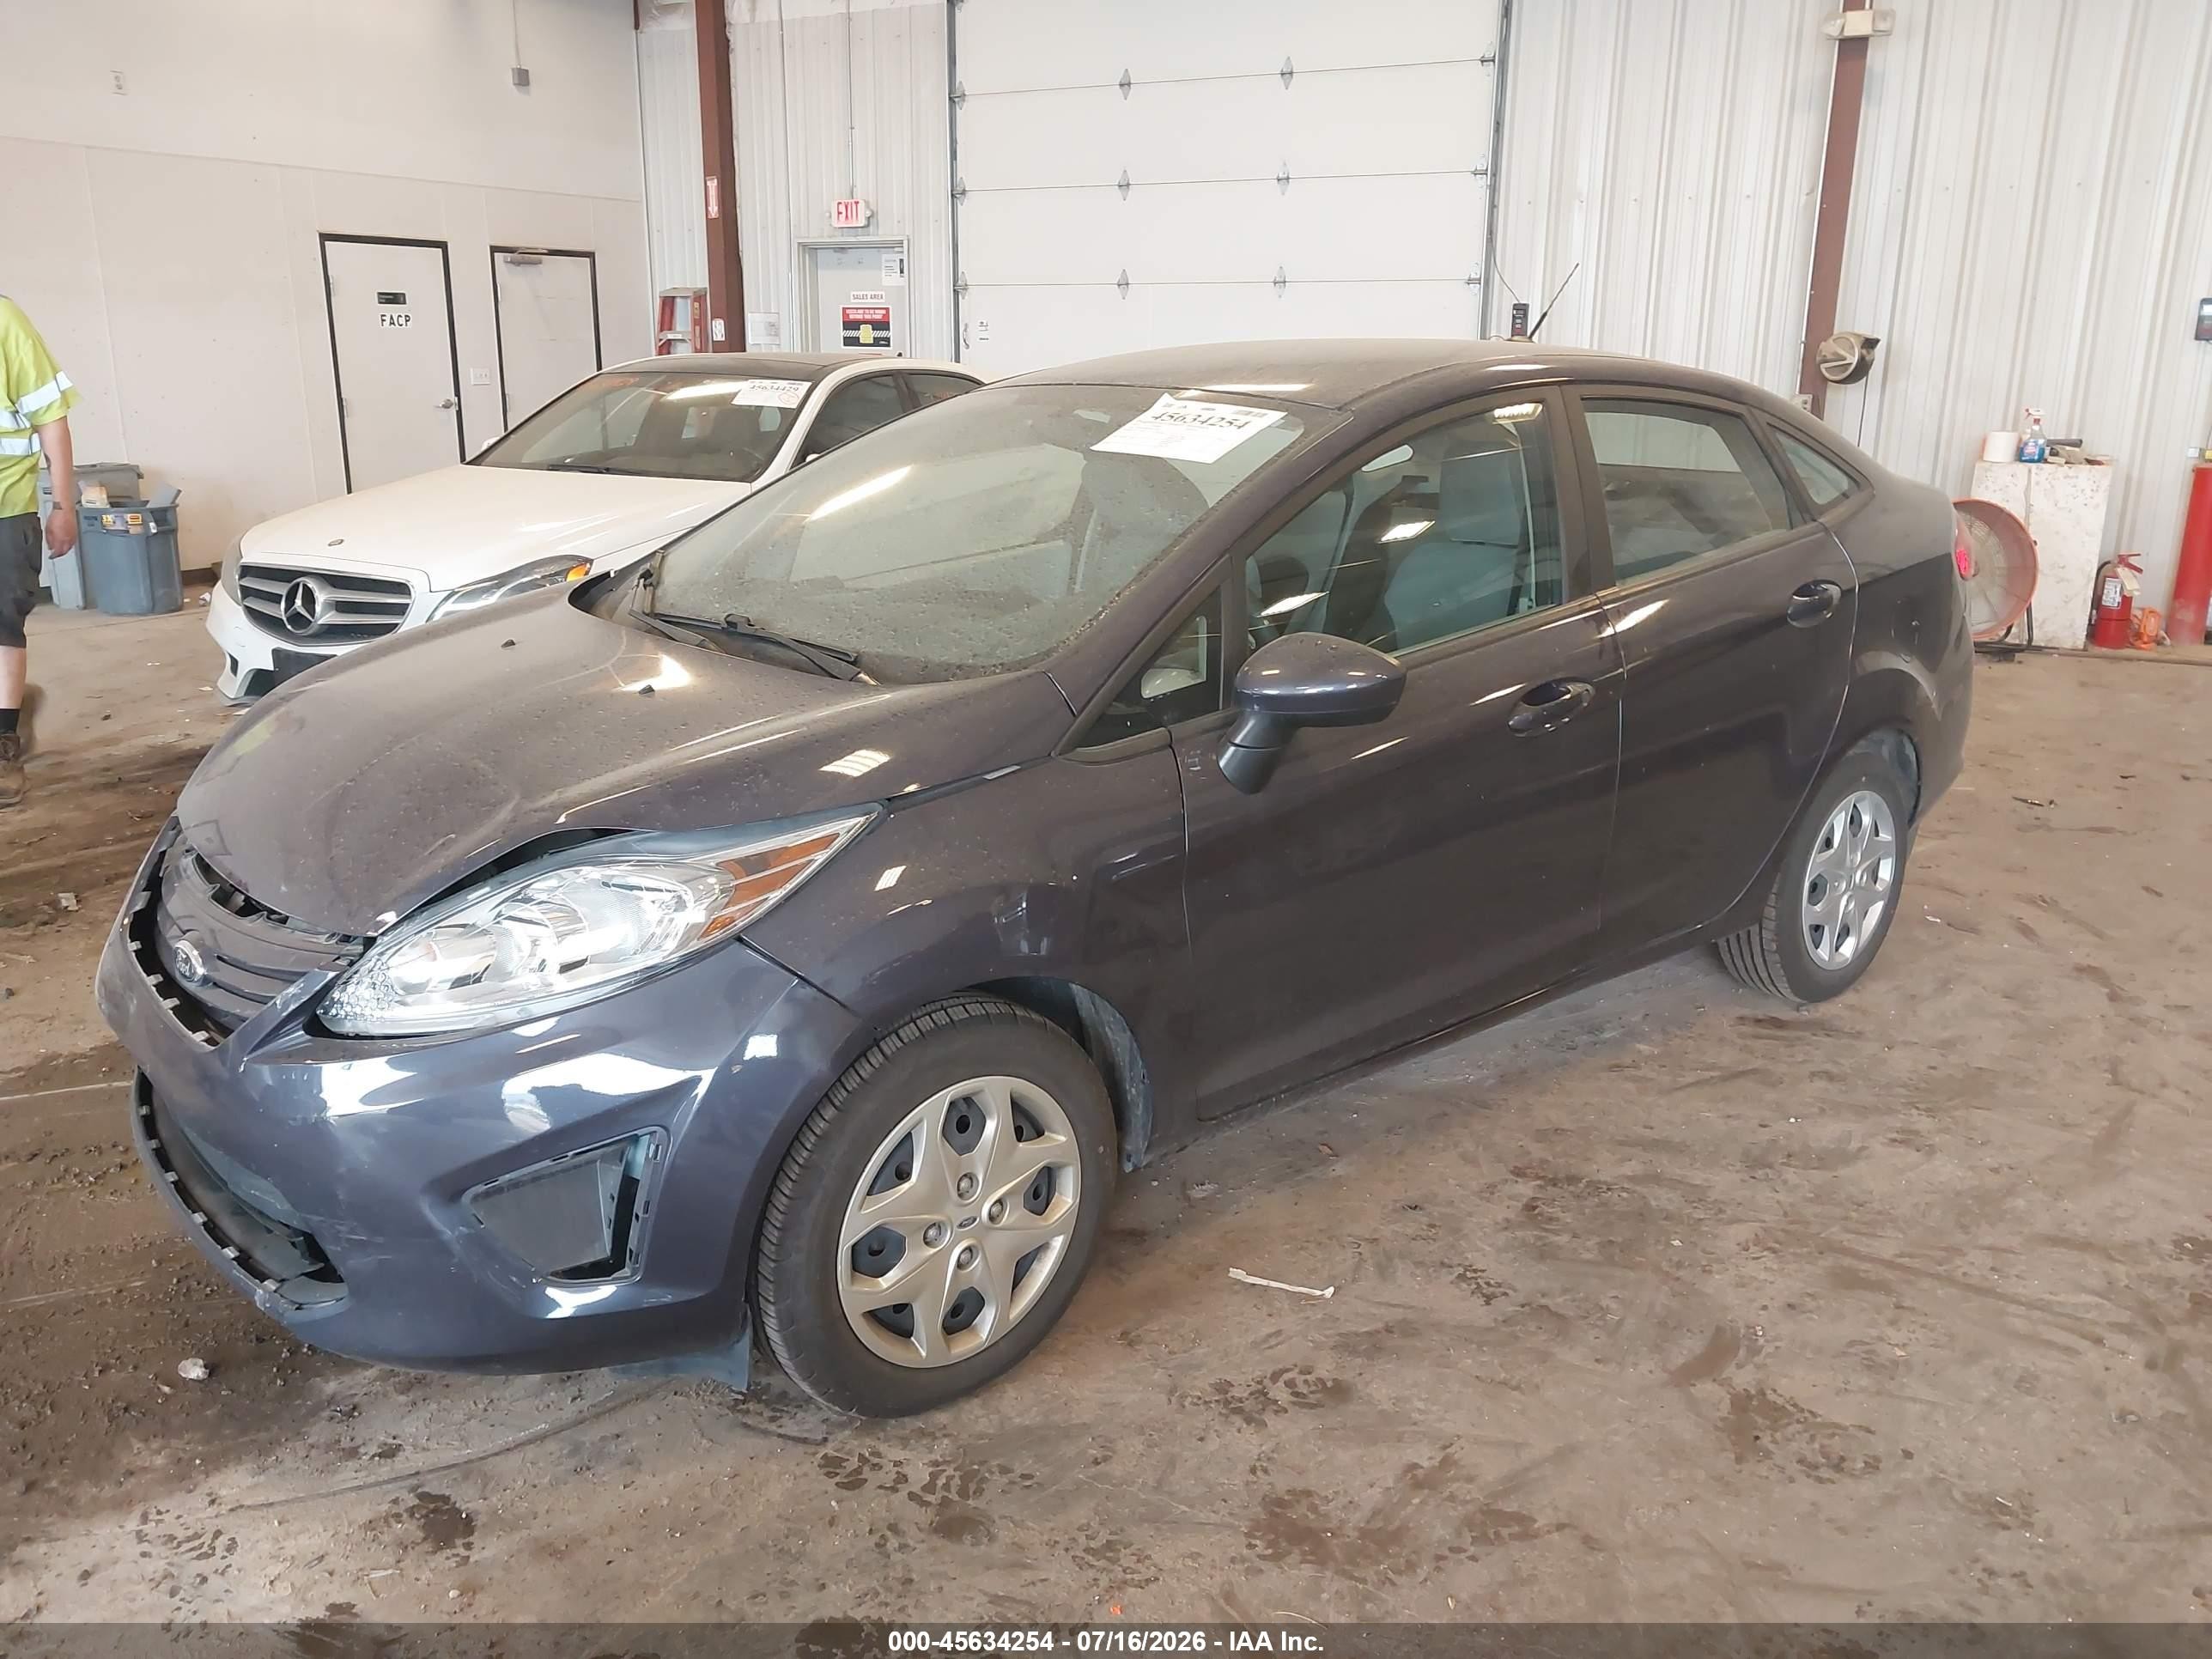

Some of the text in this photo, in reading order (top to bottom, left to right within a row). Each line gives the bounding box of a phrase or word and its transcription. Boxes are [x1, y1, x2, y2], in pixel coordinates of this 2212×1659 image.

[836, 201, 860, 221] EXIT
[380, 314, 410, 326] FACP
[1152, 411, 1251, 429] 45634254
